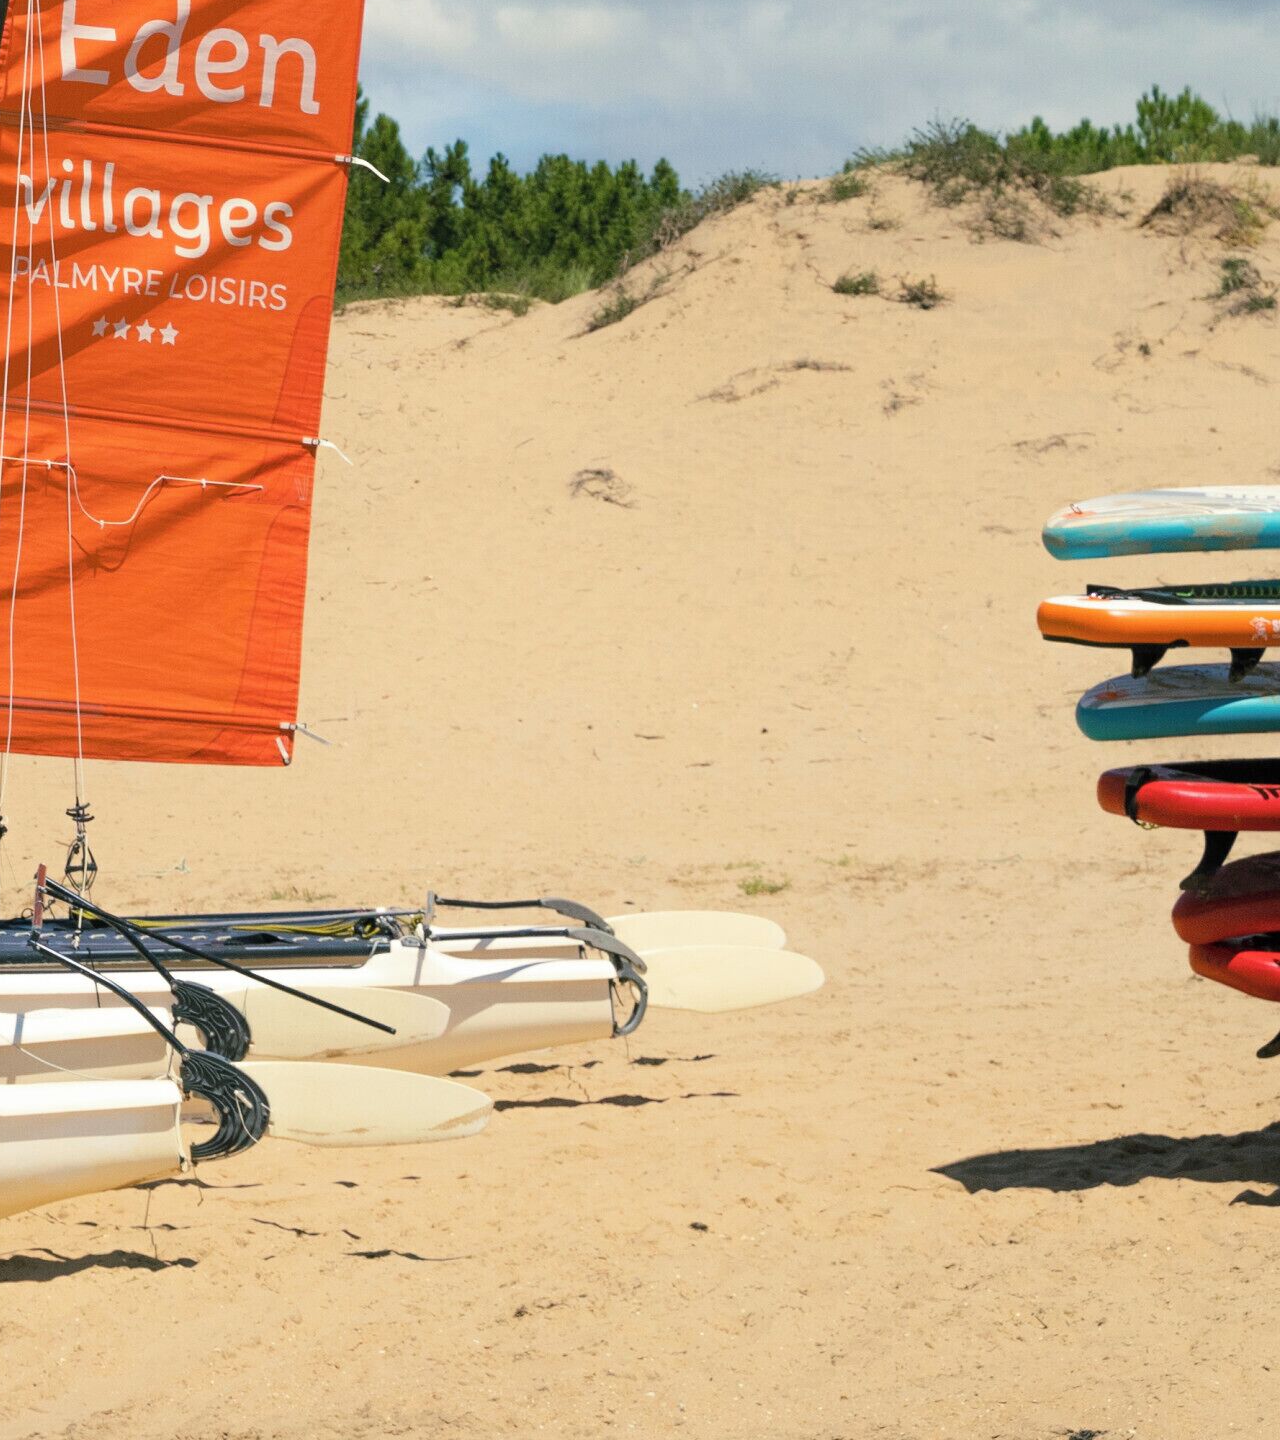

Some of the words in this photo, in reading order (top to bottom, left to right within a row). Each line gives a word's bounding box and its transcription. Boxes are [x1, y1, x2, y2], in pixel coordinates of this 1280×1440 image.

[18, 158, 294, 259] villages
[12, 255, 164, 297] PALMYRE
[169, 273, 288, 311] LOISIRS
